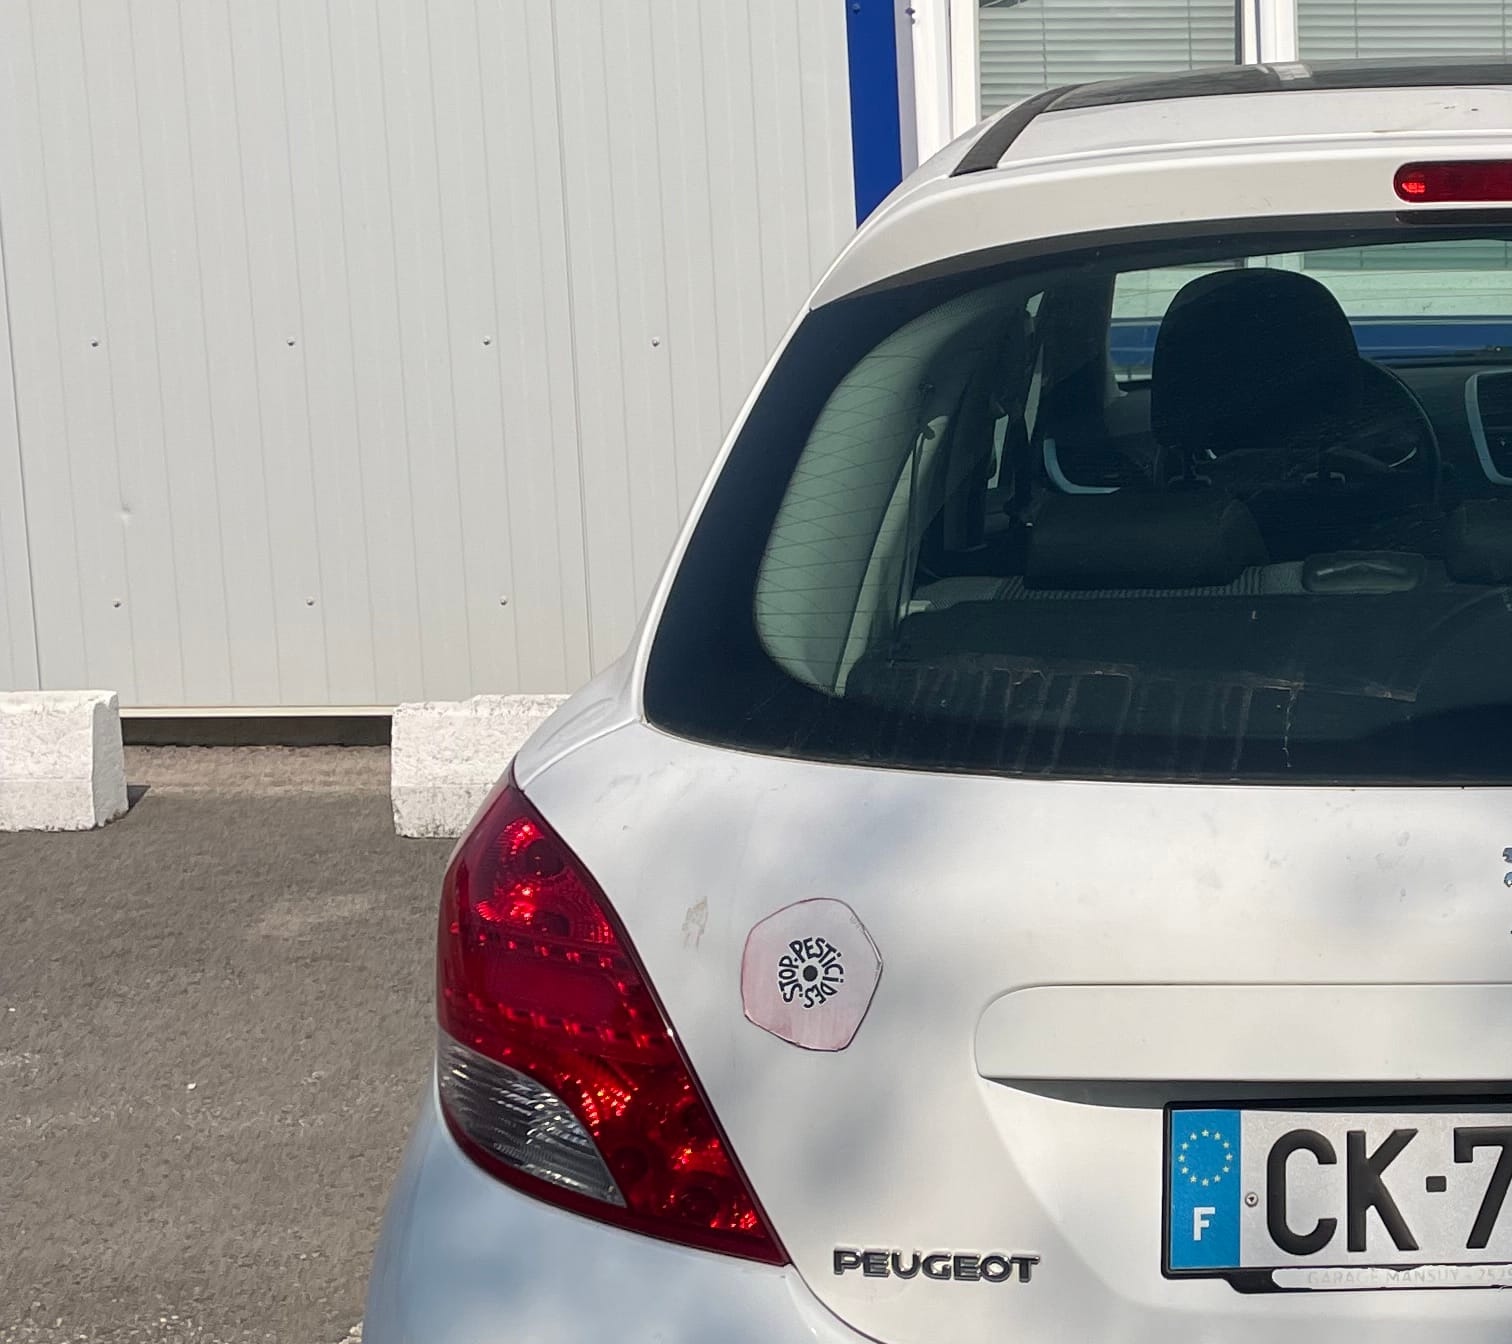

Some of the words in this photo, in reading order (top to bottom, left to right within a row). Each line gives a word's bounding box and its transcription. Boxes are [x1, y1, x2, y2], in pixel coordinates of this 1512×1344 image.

[779, 955, 803, 1003] STOP
[1193, 1206, 1216, 1241] F
[833, 1246, 1041, 1284] PEUGEOT
